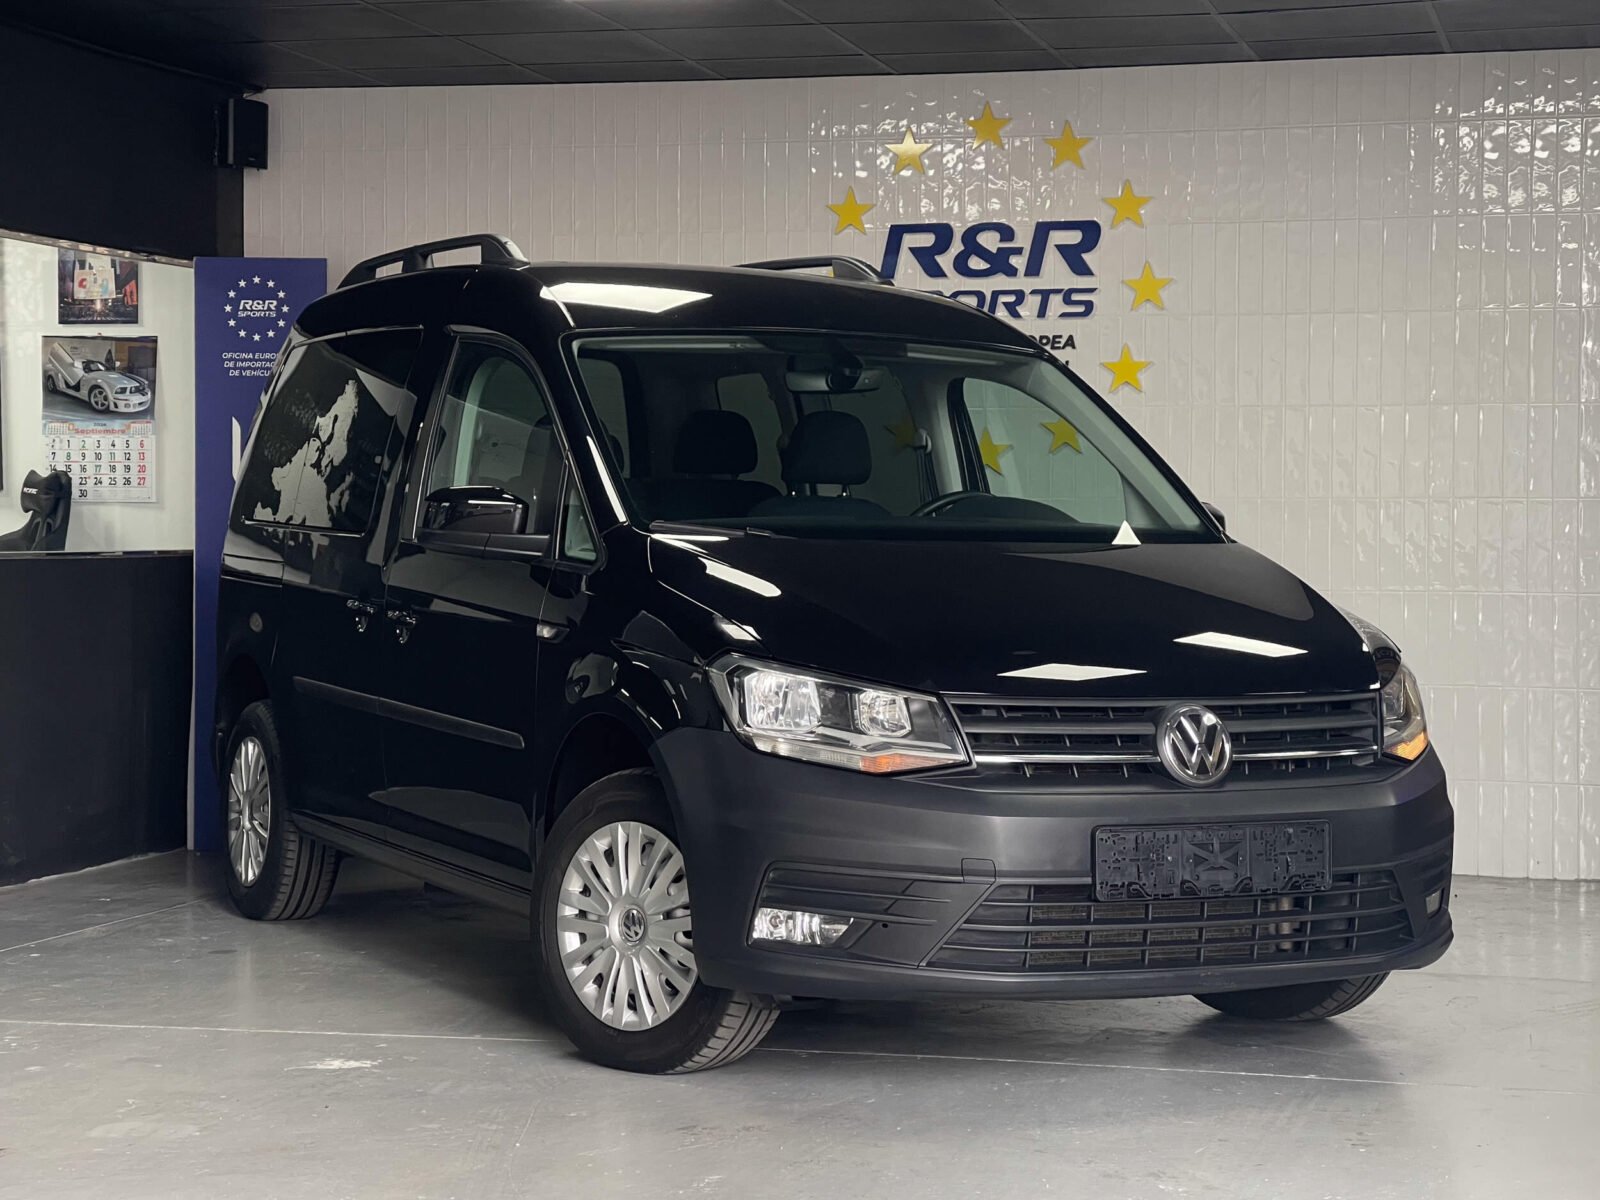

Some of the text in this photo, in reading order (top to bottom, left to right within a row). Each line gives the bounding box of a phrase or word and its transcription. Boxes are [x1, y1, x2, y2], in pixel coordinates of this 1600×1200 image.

[880, 220, 1102, 279] R&R
[240, 300, 278, 310] R&R
[928, 287, 1099, 319] ORTS
[242, 368, 270, 376] VEHÍCU
[66, 440, 144, 448] 1 2 3 4 5 6
[51, 452, 145, 460] 7 8 9 10 11 12 13
[50, 464, 146, 473] 14 15 16 17 18 19 20
[79, 477, 146, 486] 23 24 25 26 27
[78, 489, 88, 498] 30
[1164, 707, 1227, 780] VW
